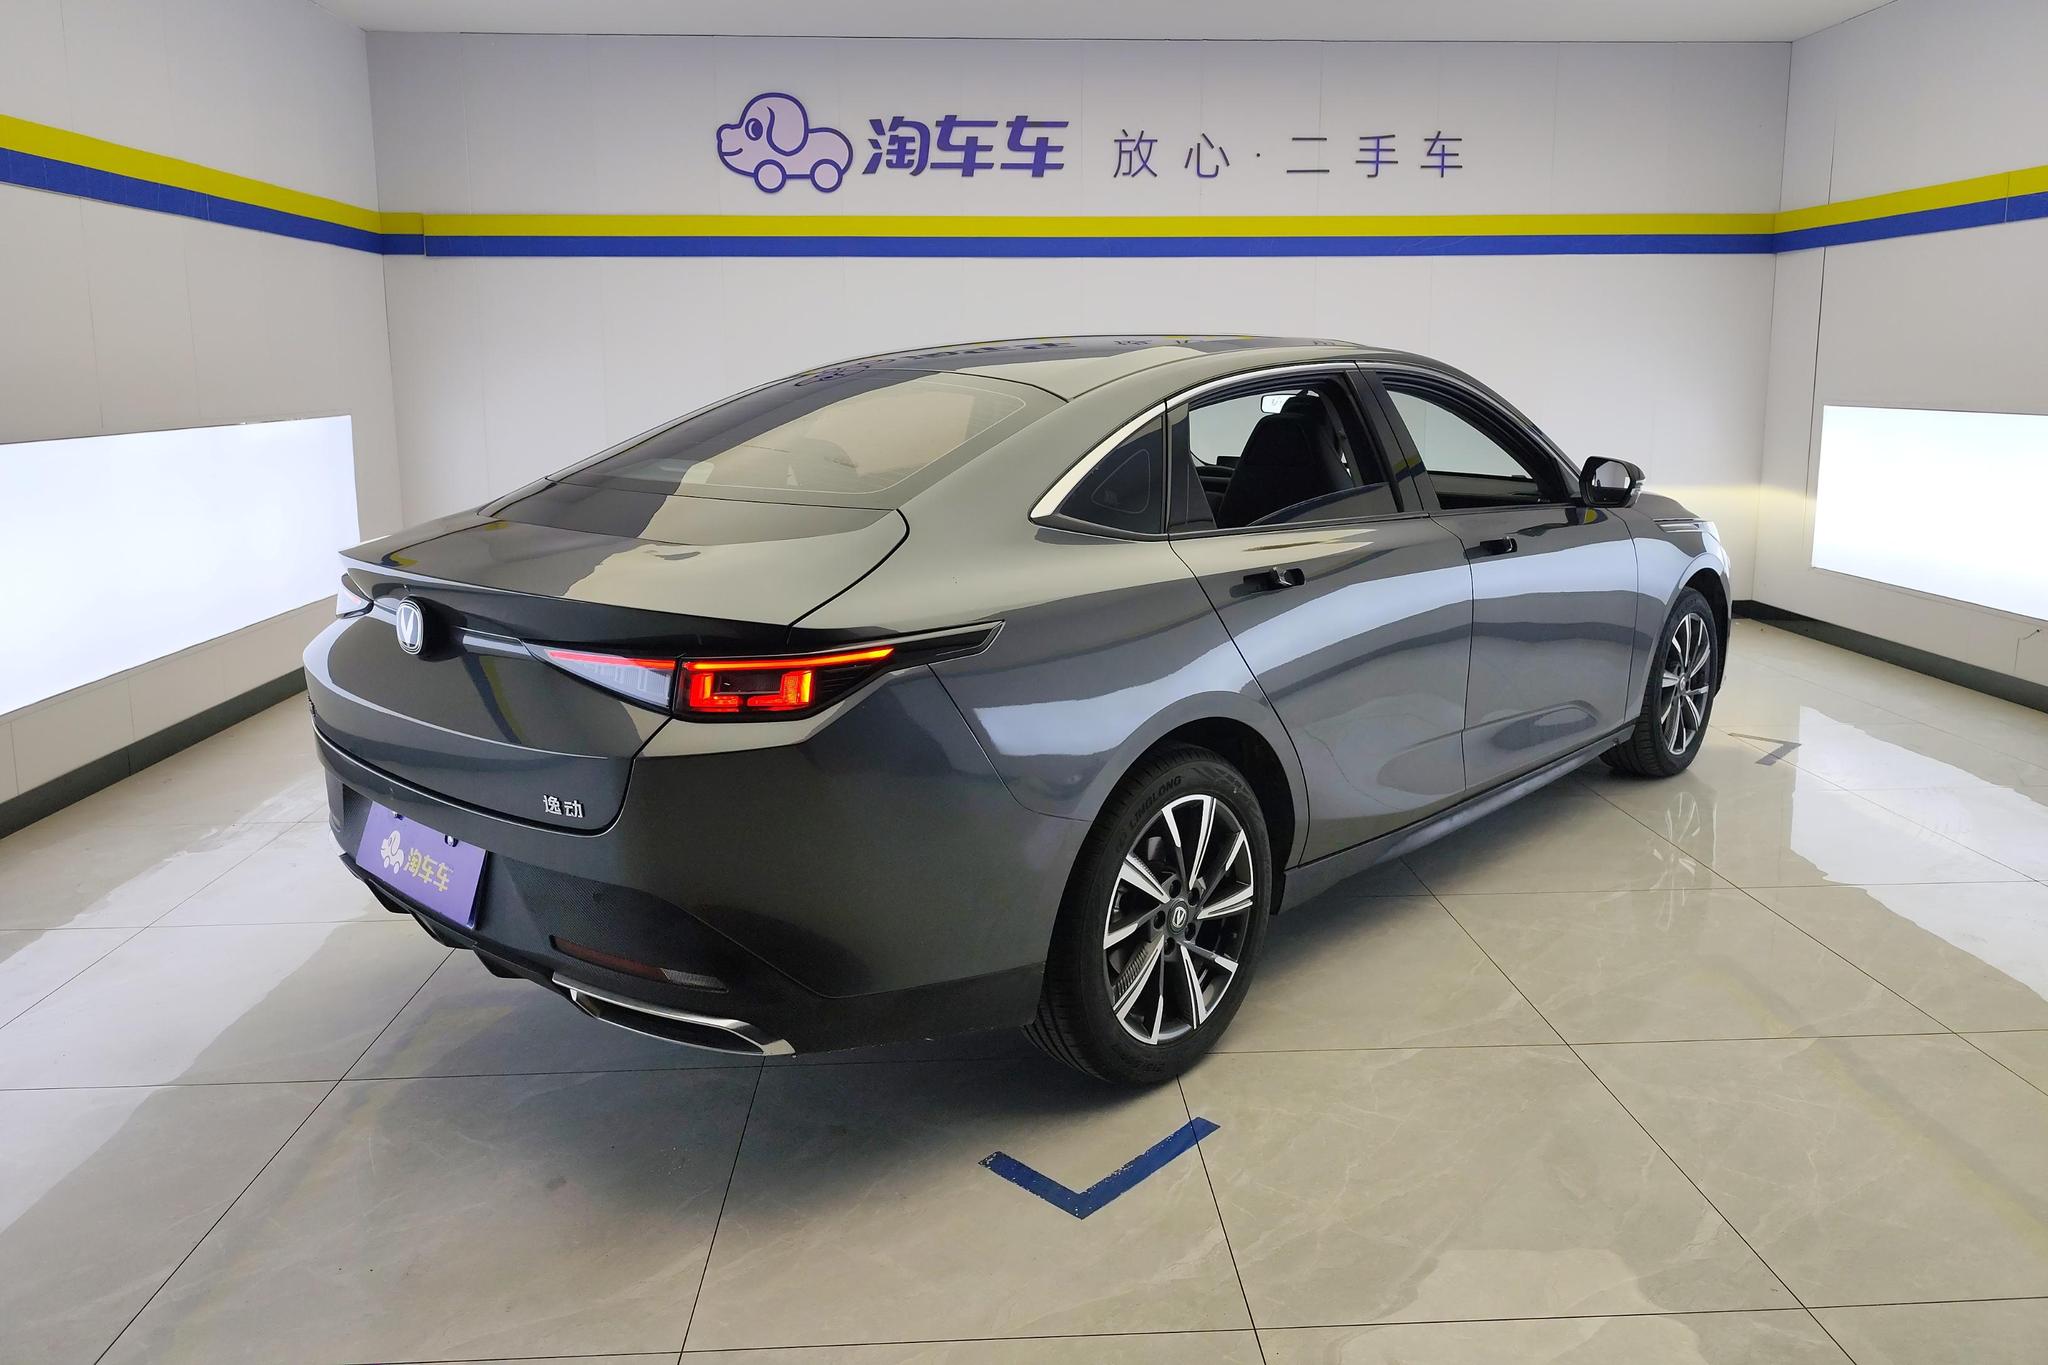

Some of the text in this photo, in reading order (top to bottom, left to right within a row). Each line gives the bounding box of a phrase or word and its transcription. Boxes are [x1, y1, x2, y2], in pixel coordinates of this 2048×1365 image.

[862, 114, 1070, 178] 淘车车
[542, 794, 585, 819] 逸动
[404, 848, 454, 891] 淘车车
